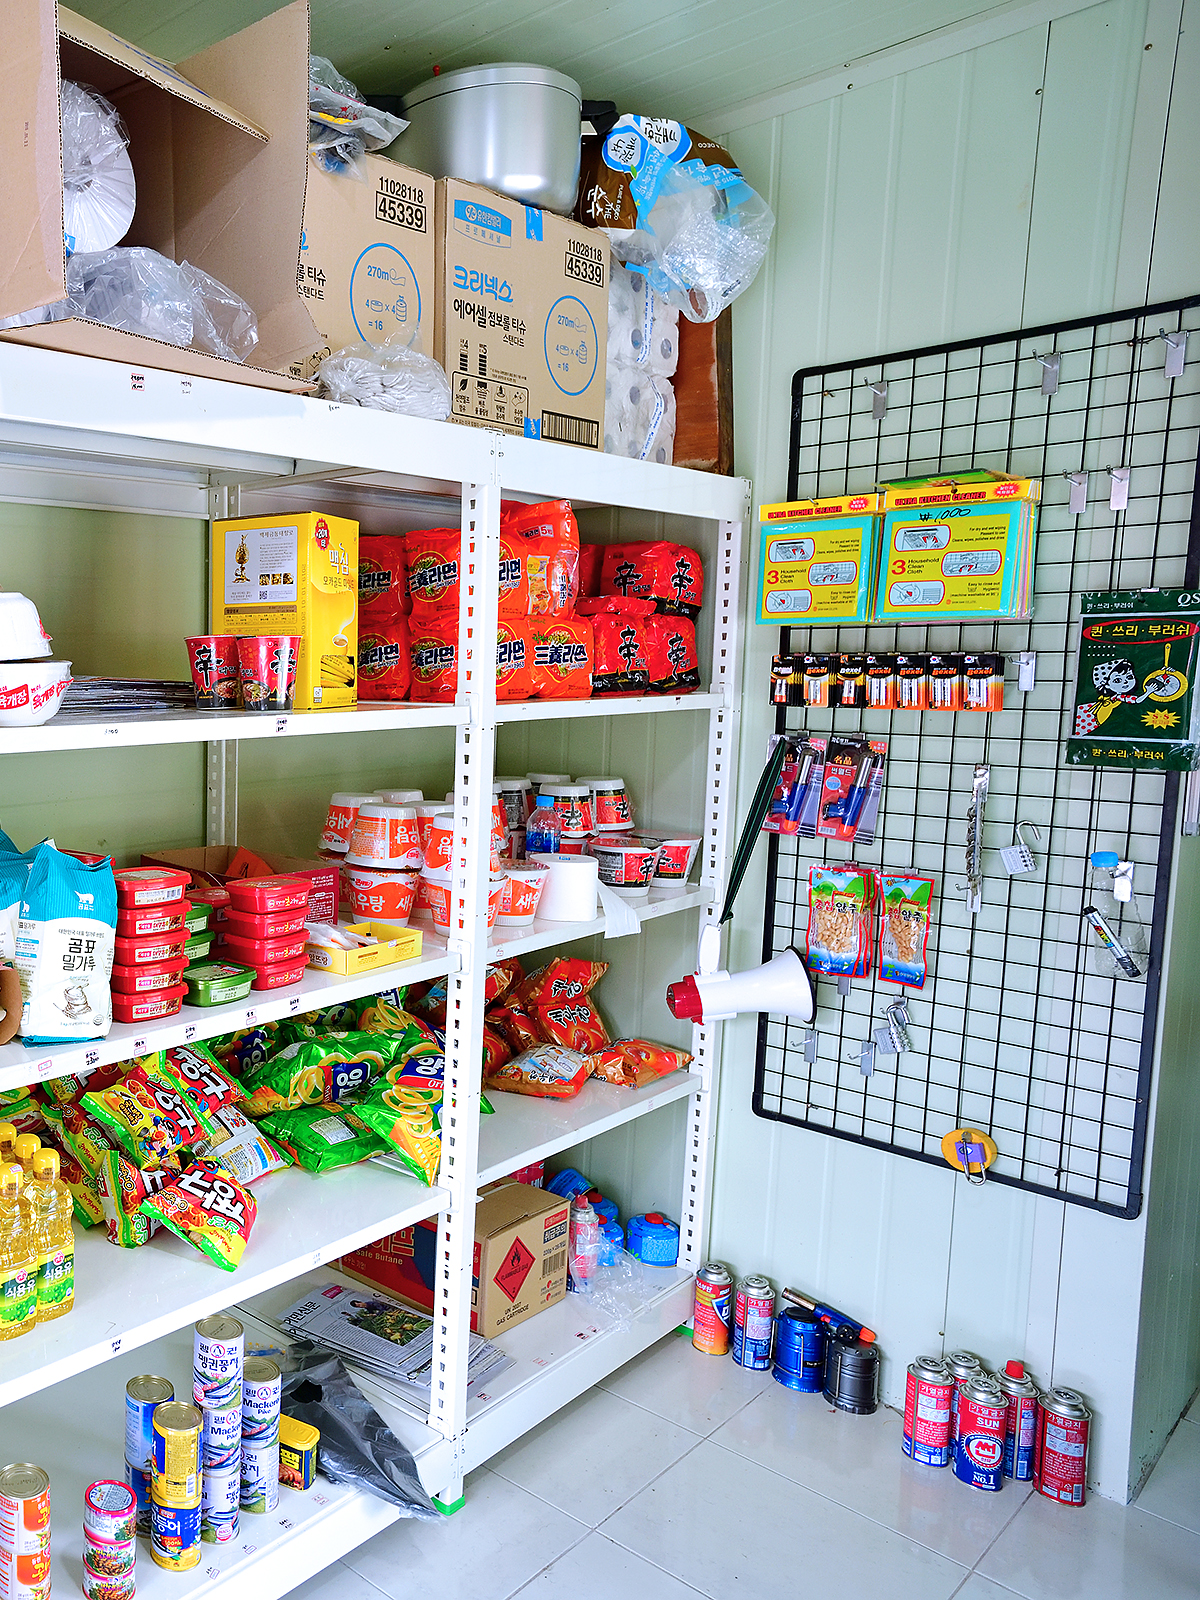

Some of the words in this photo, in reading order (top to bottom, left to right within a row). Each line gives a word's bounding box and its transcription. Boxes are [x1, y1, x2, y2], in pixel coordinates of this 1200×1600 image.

[379, 176, 424, 203] 11028118
[378, 197, 424, 228] 45339
[568, 239, 602, 261] 11028118
[307, 265, 326, 286] 티슈
[367, 265, 389, 281] 270m
[567, 257, 601, 284] 45339
[453, 265, 513, 303] 크리넥스
[375, 320, 383, 330] 16
[454, 299, 486, 328] 에어셀
[488, 310, 510, 331] 점보롤
[512, 318, 526, 335] 티슈
[558, 315, 574, 328] 270m
[503, 334, 525, 348] 스탠다드
[895, 497, 917, 506] ULTRA
[919, 494, 951, 504] KITCHEN
[952, 492, 986, 501] CLEANER
[768, 511, 786, 519] ULTRA
[815, 506, 842, 514] CLEANER
[329, 549, 350, 575] 맥심
[892, 560, 906, 575] 3
[767, 570, 779, 584] 3
[619, 625, 640, 677] 辛
[194, 645, 224, 688] 辛
[32, 685, 56, 709] 육개장
[69, 938, 97, 953] 곰표
[62, 955, 96, 971] 밀가루
[375, 1253, 404, 1265] Butane
[43, 1262, 72, 1281] 식용유
[5, 1280, 36, 1298] 식용유
[496, 1316, 506, 1326] GAS
[506, 1304, 530, 1322] CARTRIDGE
[198, 1353, 239, 1372] 펭귄꽁치
[921, 1385, 950, 1397] 가열금지
[976, 1417, 999, 1428] SUN
[1047, 1413, 1081, 1429] 가열금지
[227, 1433, 238, 1441] Pike
[973, 1474, 995, 1486] NO.1
